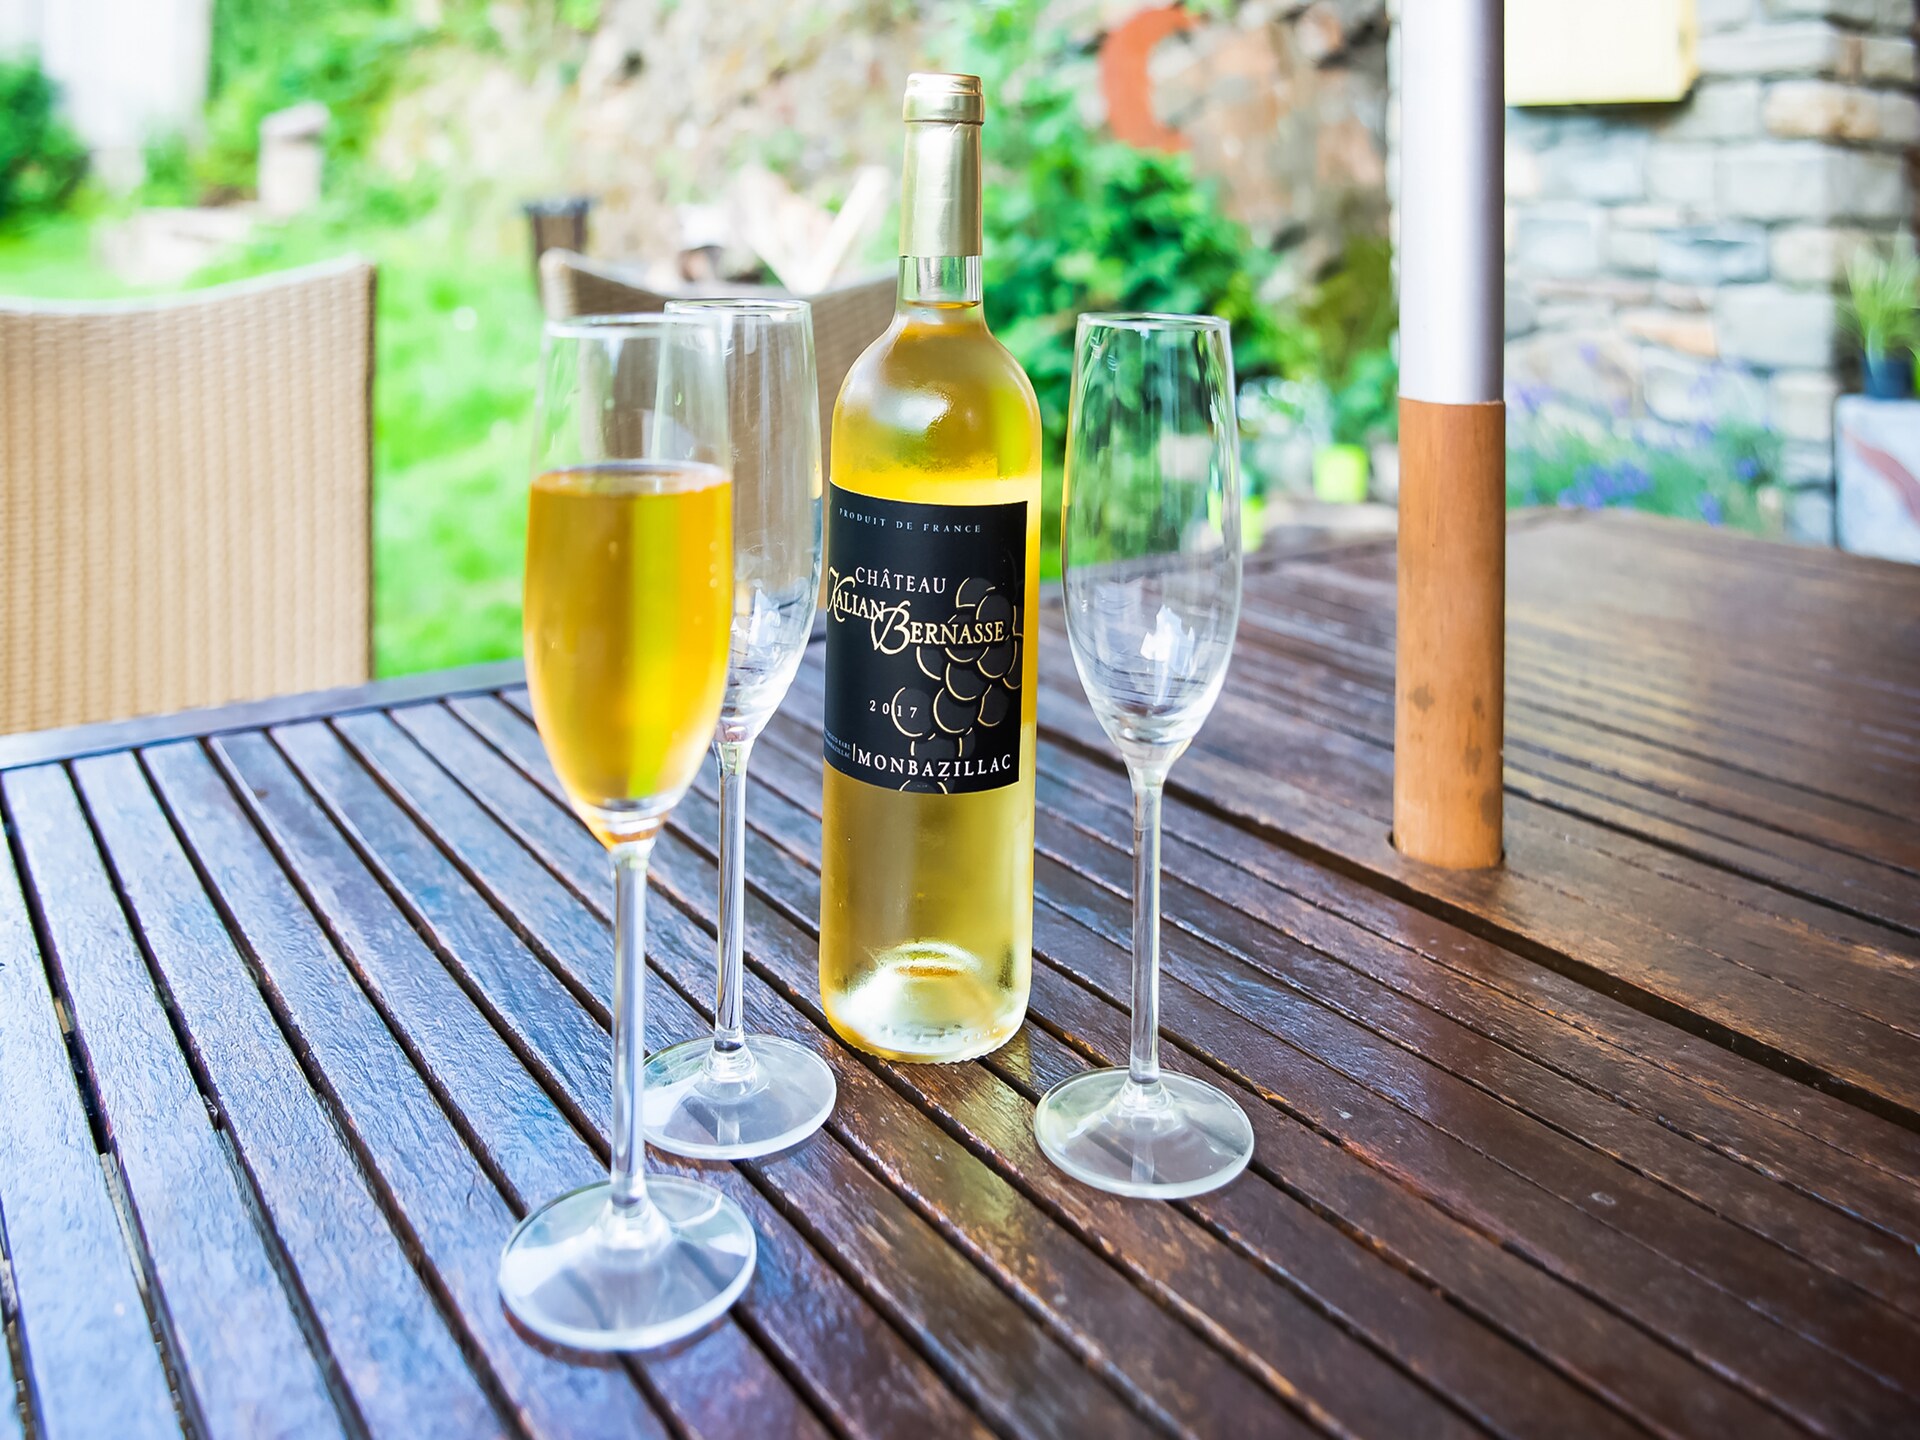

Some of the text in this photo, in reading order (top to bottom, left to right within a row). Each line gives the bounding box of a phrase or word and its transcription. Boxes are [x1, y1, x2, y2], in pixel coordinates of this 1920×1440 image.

[839, 507, 982, 533] PRODUIT DE FRANCE
[855, 566, 947, 594] CHÂTEAU
[870, 600, 1005, 655] BERNASSE
[869, 699, 918, 719] 2017
[857, 748, 1011, 778] MONBAZILLAC
